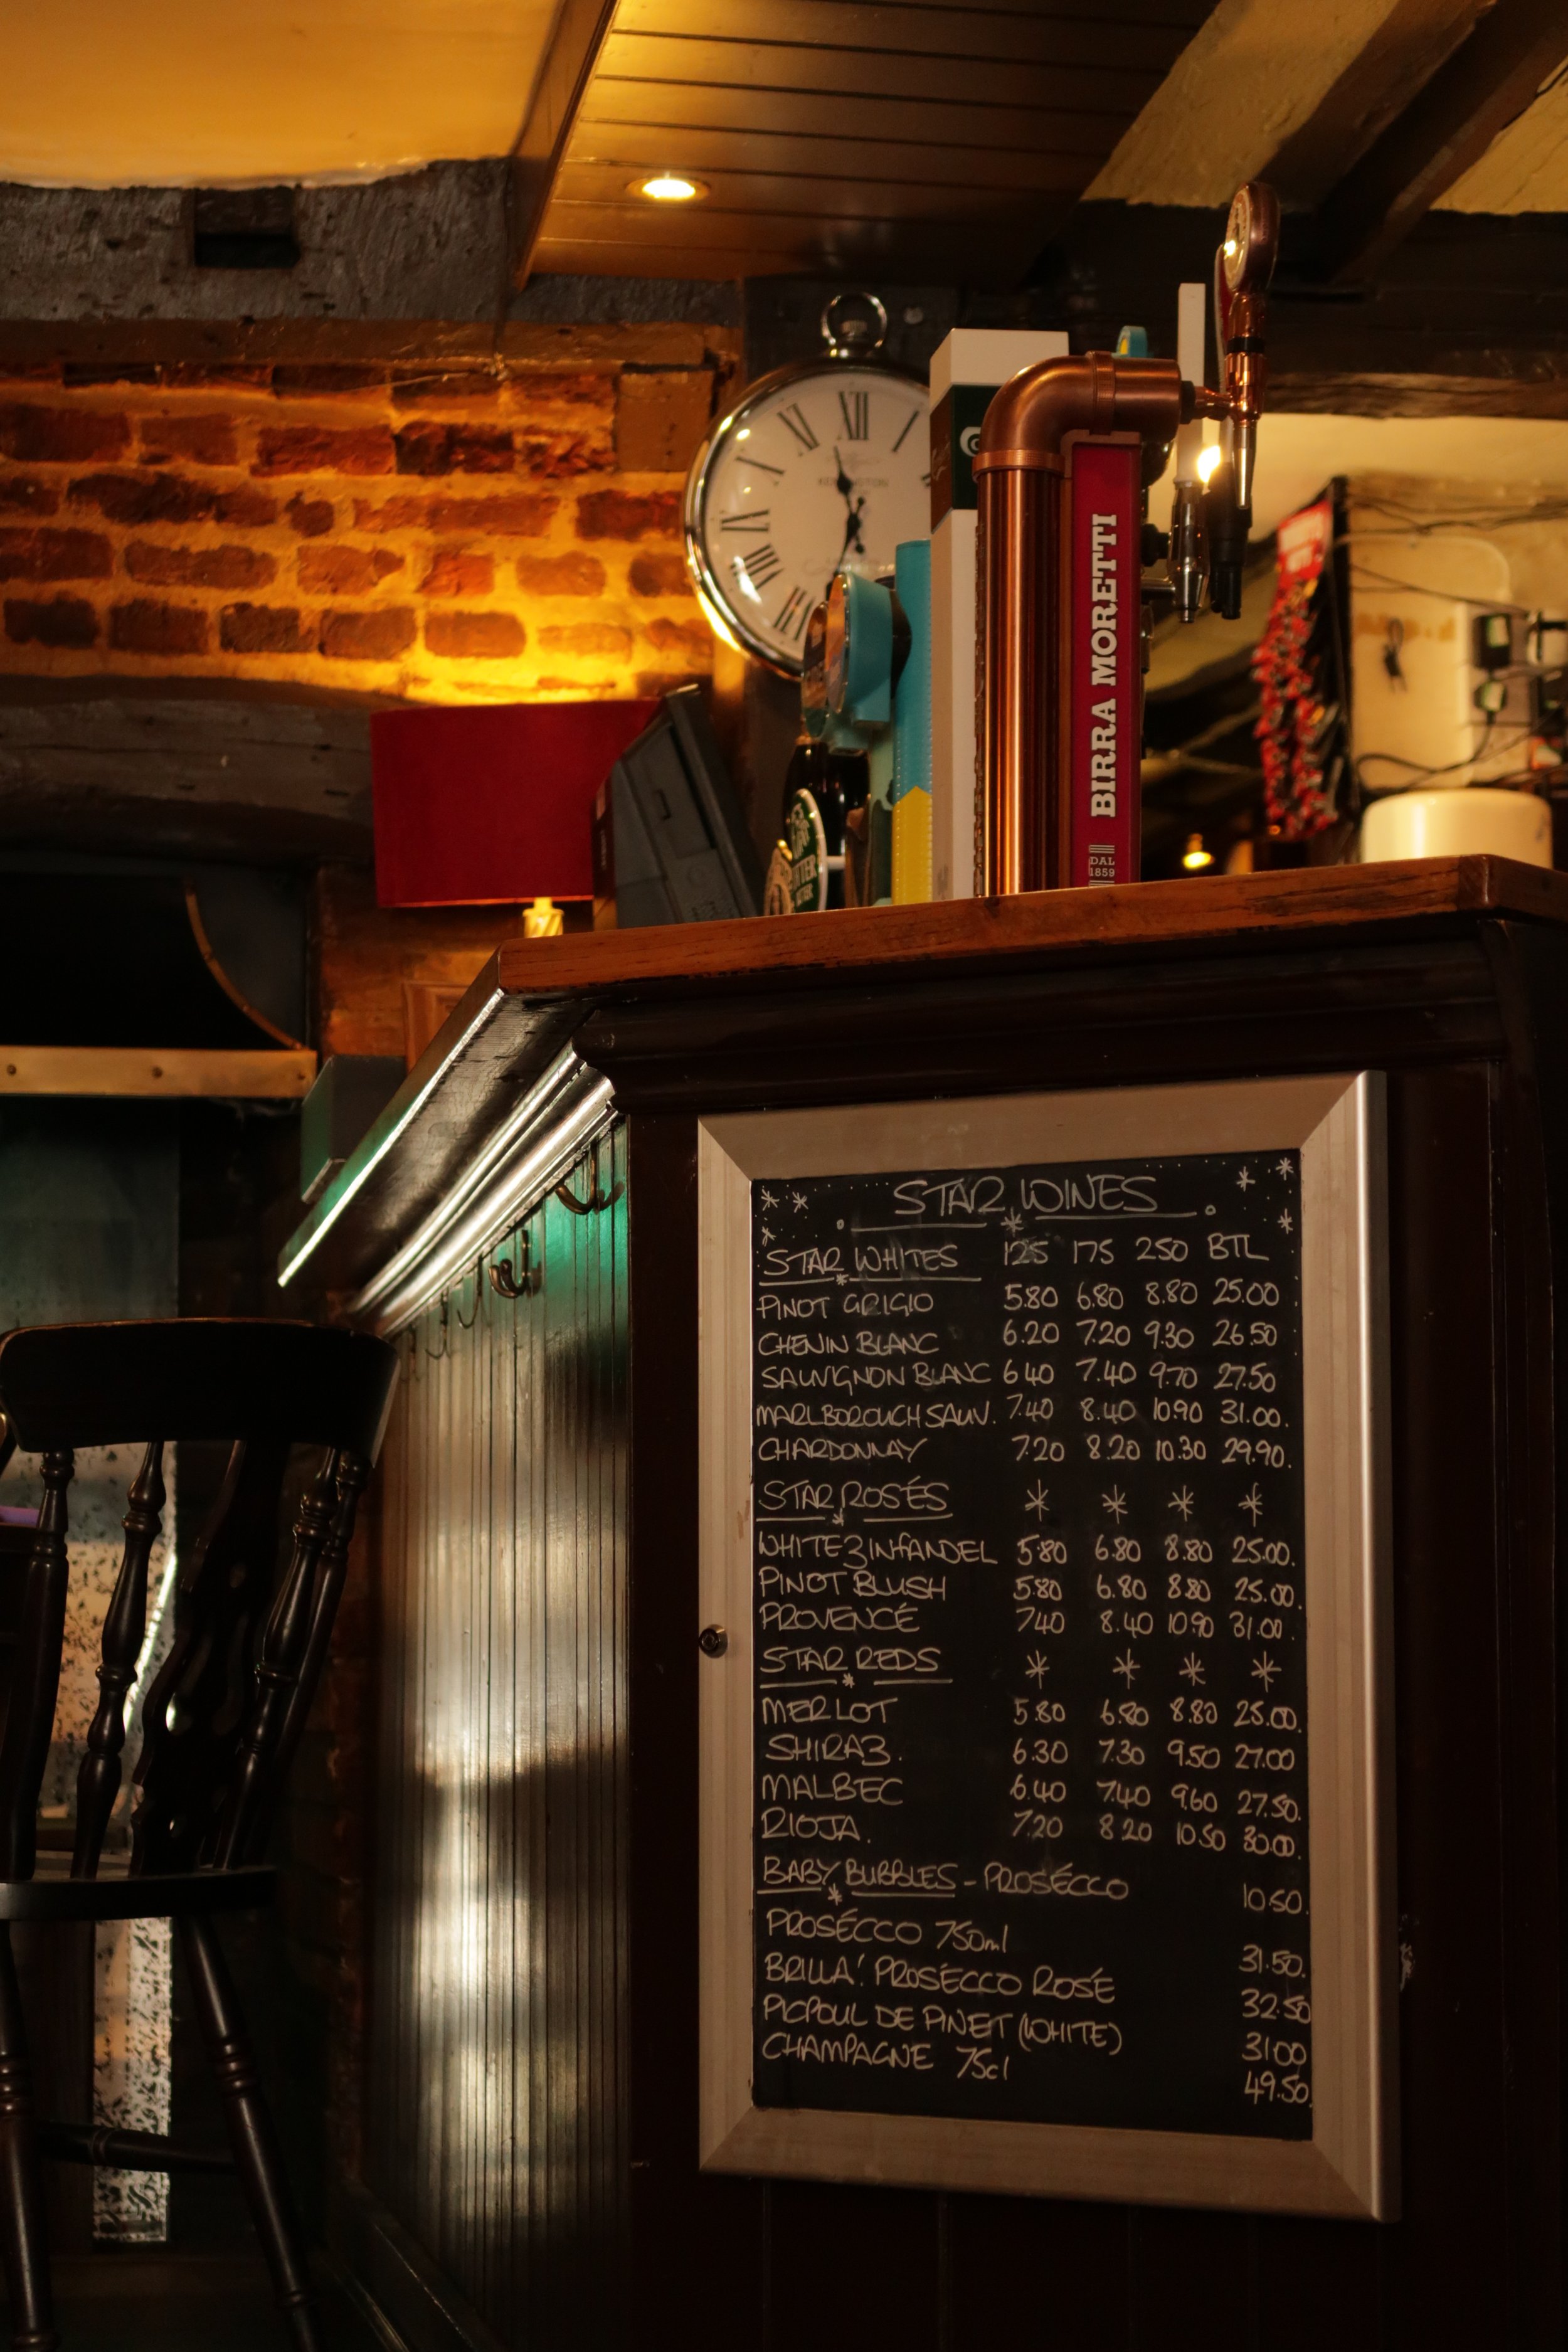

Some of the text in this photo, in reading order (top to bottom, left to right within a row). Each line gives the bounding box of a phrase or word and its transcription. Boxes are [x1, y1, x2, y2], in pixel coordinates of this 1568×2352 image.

[1092, 514, 1118, 817] BIRRA MORETTI
[1089, 857, 1115, 865] DAL
[1089, 868, 1115, 877] 1859
[894, 1174, 1157, 1216] STAR WINES
[764, 1233, 1269, 1275] STAR WHITES 125 175 250 BTL
[756, 1278, 1279, 1320] PINOT GRIGIO 5.80 6.80 8.80 25.00
[758, 1319, 1277, 1355] CHENIN BLANC 6.20 7.20 9.30 26.50
[761, 1365, 904, 1396] SAUVIGNON
[913, 1362, 991, 1385] BLANC
[1076, 1358, 1136, 1387] 7.40
[1150, 1362, 1197, 1389] 9.70
[1214, 1362, 1276, 1392] 27.50
[1007, 1394, 1053, 1422] 7.40
[1081, 1397, 1136, 1424] 8.40
[1153, 1397, 1202, 1422] 10.90
[758, 1438, 928, 1463] CHARDONNAY
[1012, 1435, 1064, 1461] 7.20
[1087, 1434, 1140, 1460] 8.20
[1156, 1436, 1205, 1461] 10.30
[759, 1476, 949, 1515] STAR ROSÉS
[759, 1531, 842, 1557] WHITE
[1017, 1534, 1067, 1565] 5.80
[1095, 1534, 1141, 1562] 6.80
[1165, 1534, 1212, 1562] 8.80
[759, 1566, 847, 1597] PINOT
[853, 1570, 945, 1601] BLUSH
[1014, 1576, 1062, 1601] 5.80
[1097, 1574, 1147, 1600] 6.80
[760, 1602, 919, 1632] PROVENCÉ
[1100, 1609, 1153, 1638] 8.40
[1168, 1612, 1214, 1638] 10.90
[760, 1646, 940, 1673] STAR REDS
[762, 1696, 898, 1724] MERLOT
[1014, 1698, 1065, 1725] 5.80
[1100, 1699, 1148, 1726] 6.80
[1170, 1697, 1217, 1724] 8.80
[1013, 1738, 1068, 1764] 6.30
[1099, 1739, 1145, 1764] 7.30
[1168, 1740, 1220, 1769] 9.50
[1236, 1744, 1295, 1771] 27.00
[762, 1772, 903, 1805] MALBEC
[1010, 1774, 1066, 1803] 6.40
[1097, 1780, 1150, 1809] 7.40
[1171, 1784, 1217, 1812] 9.60
[1013, 1809, 1062, 1838] 7.20
[764, 1856, 840, 1885] BABY
[845, 1858, 958, 1889] BUBBLES
[984, 1862, 1128, 1899] PROSÉCCO
[766, 1908, 921, 1944] PROSÉCCO
[935, 1920, 1008, 1952] 750ml
[875, 1956, 1022, 1995] PROSÉCCO
[1033, 1966, 1115, 2003] ROSÉ
[1241, 1989, 1311, 2024] 32.50
[763, 1994, 867, 2026] PICPOUL
[875, 2005, 914, 2030] DE
[923, 2005, 1013, 2038] PINET
[1019, 2013, 1121, 2055] (WHITE)
[762, 2032, 933, 2069] CHAMPAGNE
